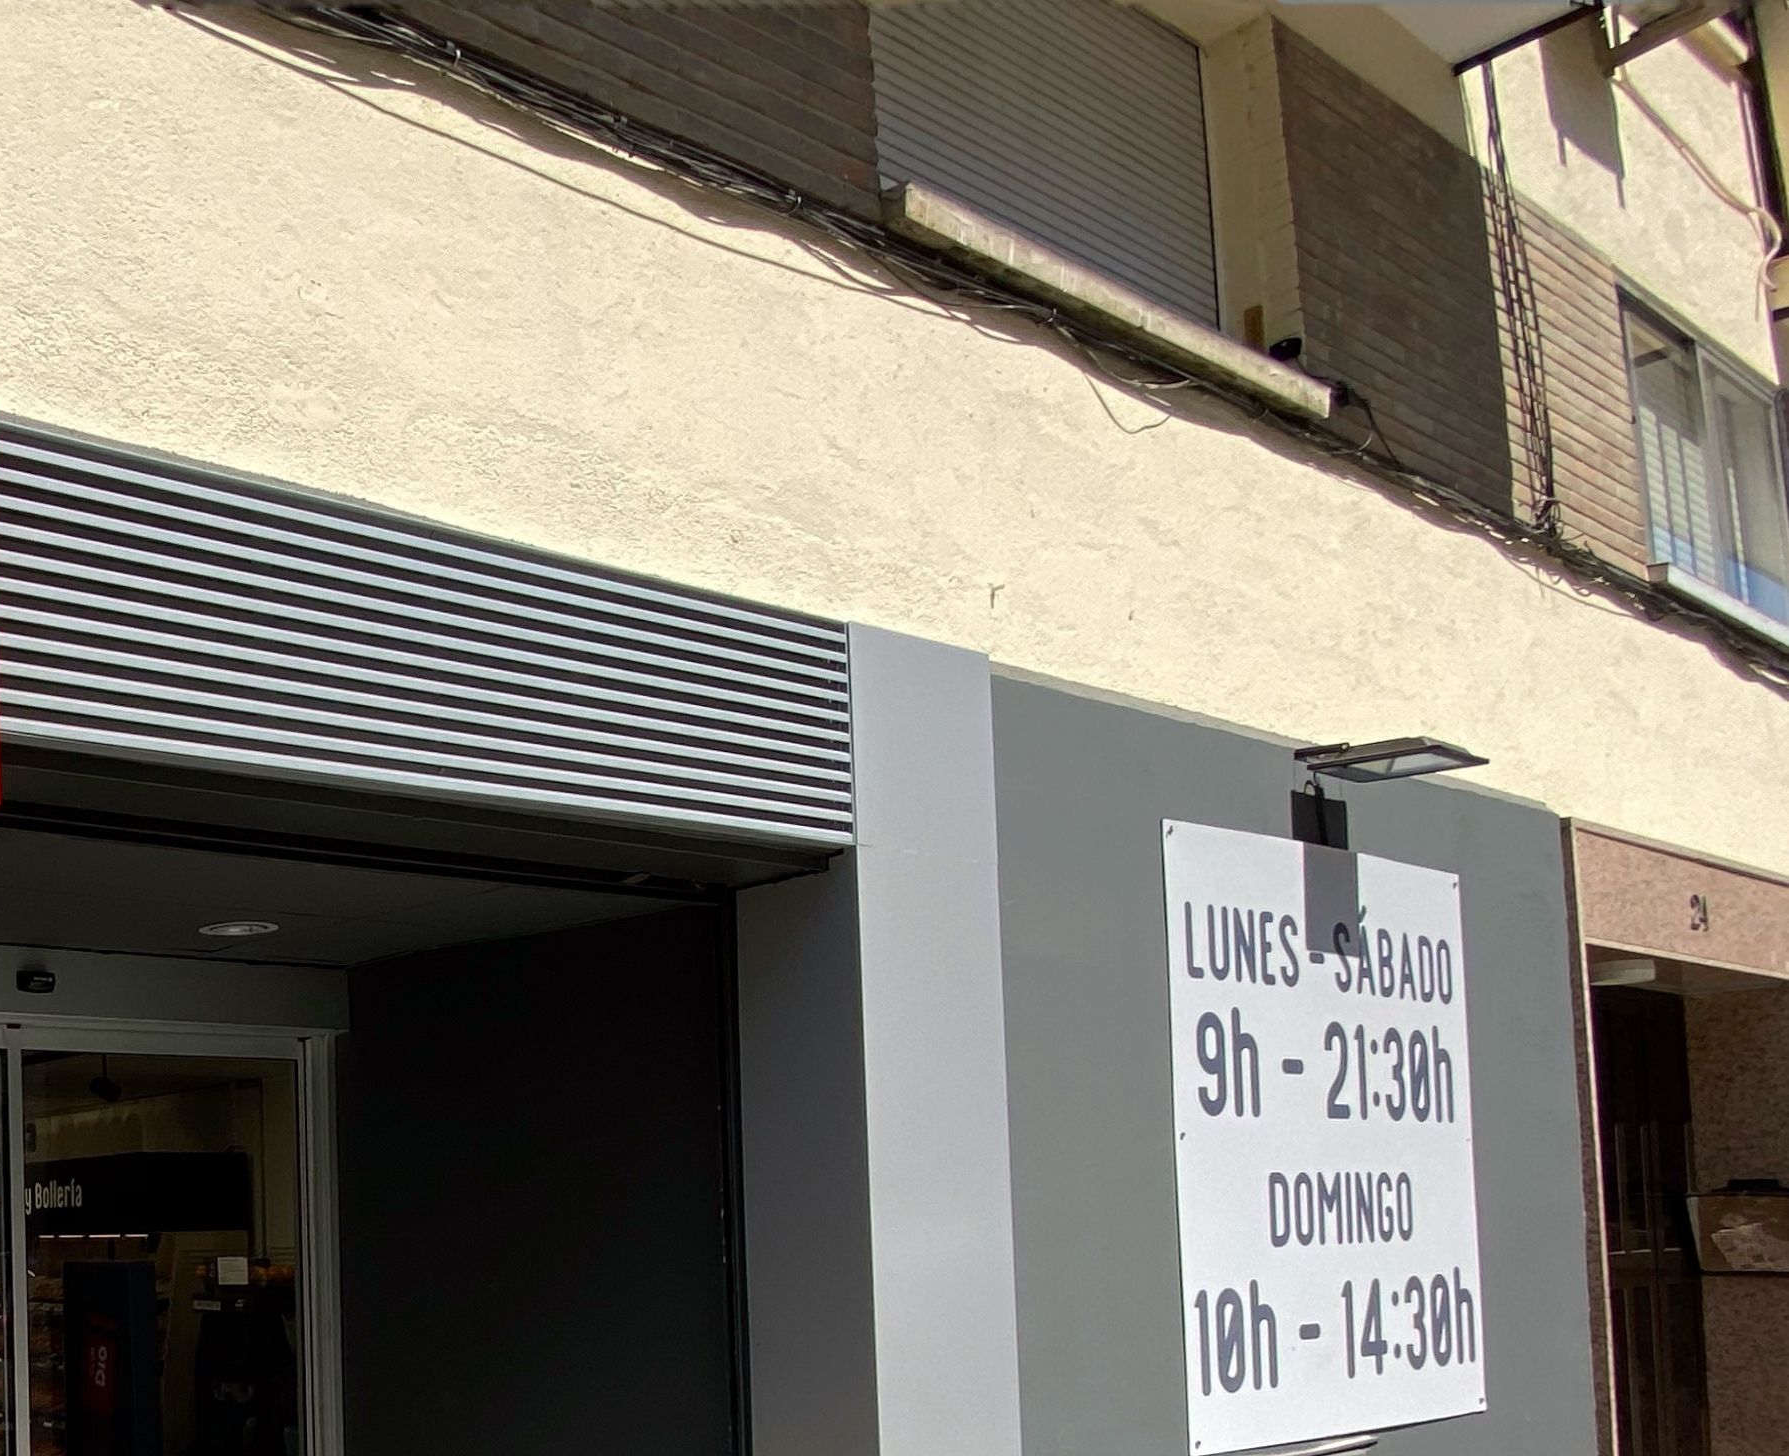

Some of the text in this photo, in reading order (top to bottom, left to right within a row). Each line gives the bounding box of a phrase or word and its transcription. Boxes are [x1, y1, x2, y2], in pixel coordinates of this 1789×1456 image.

[1184, 900, 1299, 988] LUNES
[1332, 905, 1453, 1006] SÁBADO
[1195, 1005, 1262, 1118] 9h
[1323, 1021, 1455, 1124] 21:30h
[35, 1178, 83, 1209] Bollería
[1268, 1170, 1413, 1249] DOMINGO
[1193, 1279, 1279, 1397] 10h
[1341, 1266, 1478, 1379] 14:30h
